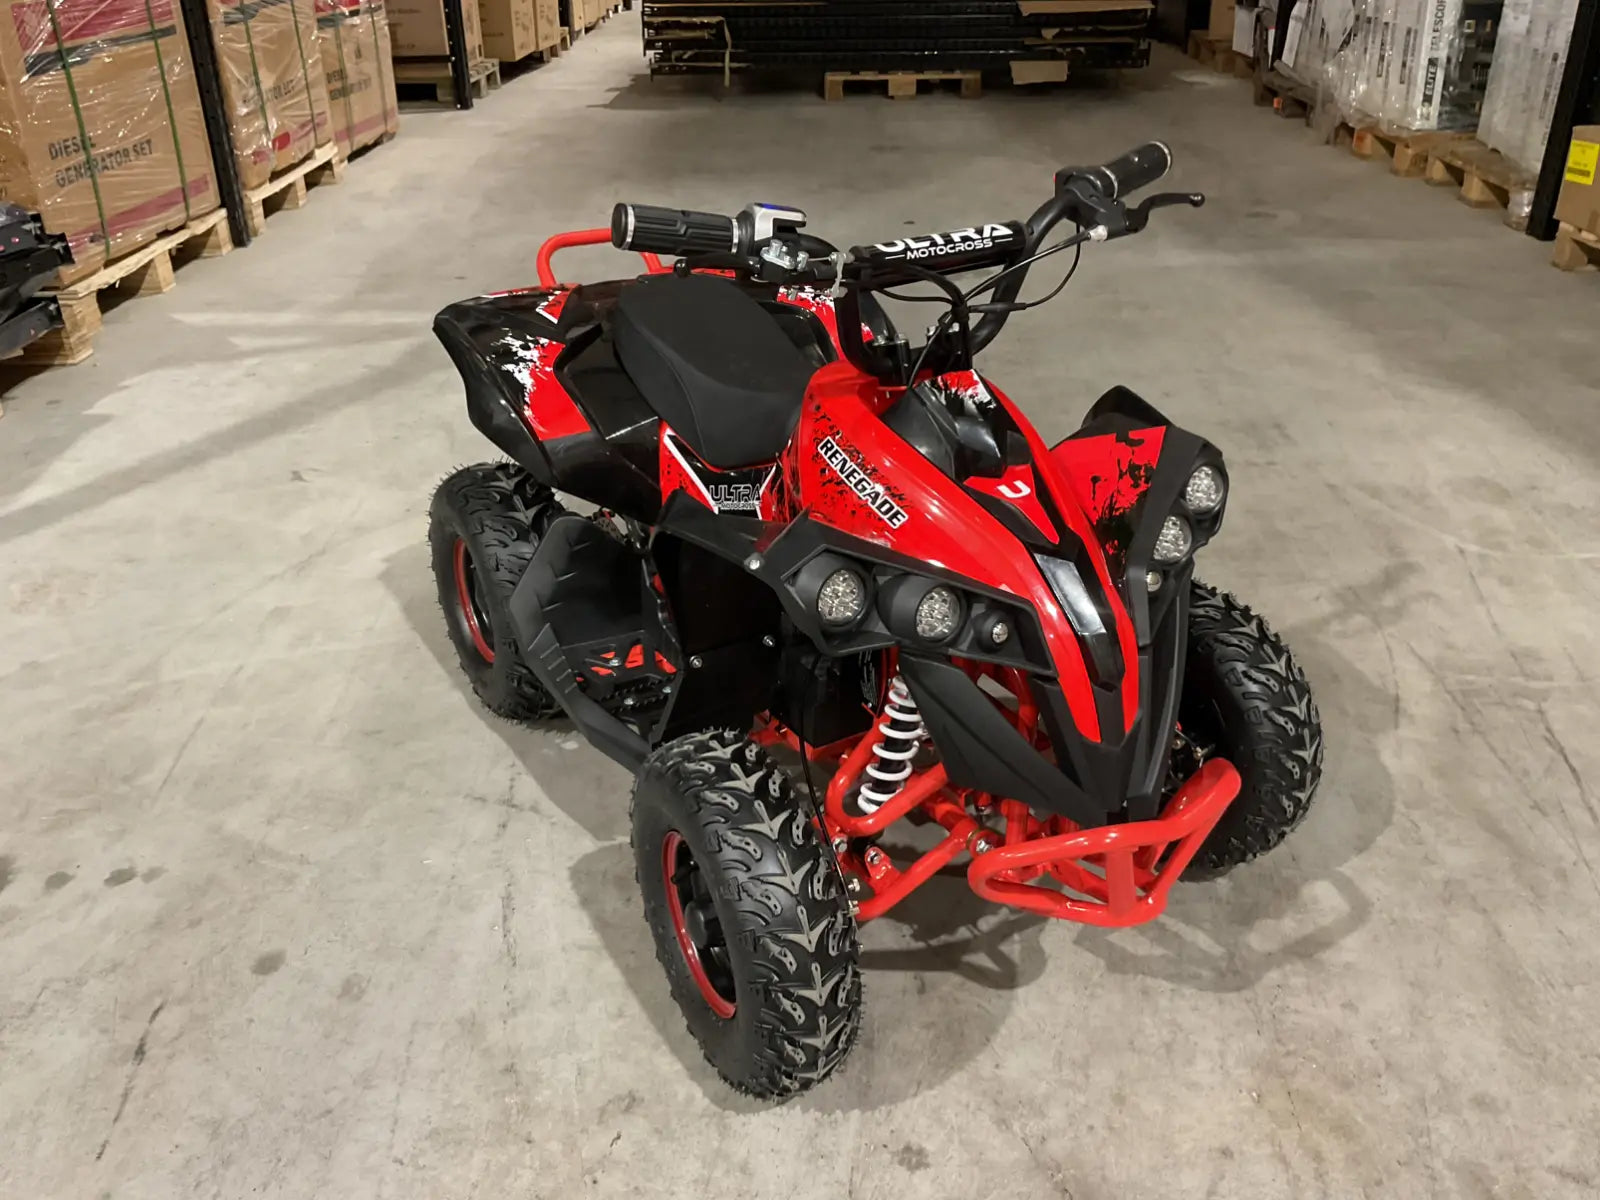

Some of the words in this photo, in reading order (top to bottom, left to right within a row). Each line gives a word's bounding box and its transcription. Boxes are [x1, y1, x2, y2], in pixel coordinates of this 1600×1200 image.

[1424, 64, 1437, 95] ELITE
[132, 138, 153, 157] SET
[906, 238, 993, 260] MOTOCROSS
[709, 483, 761, 503] ULTRA
[818, 436, 908, 529] RENEGADE
